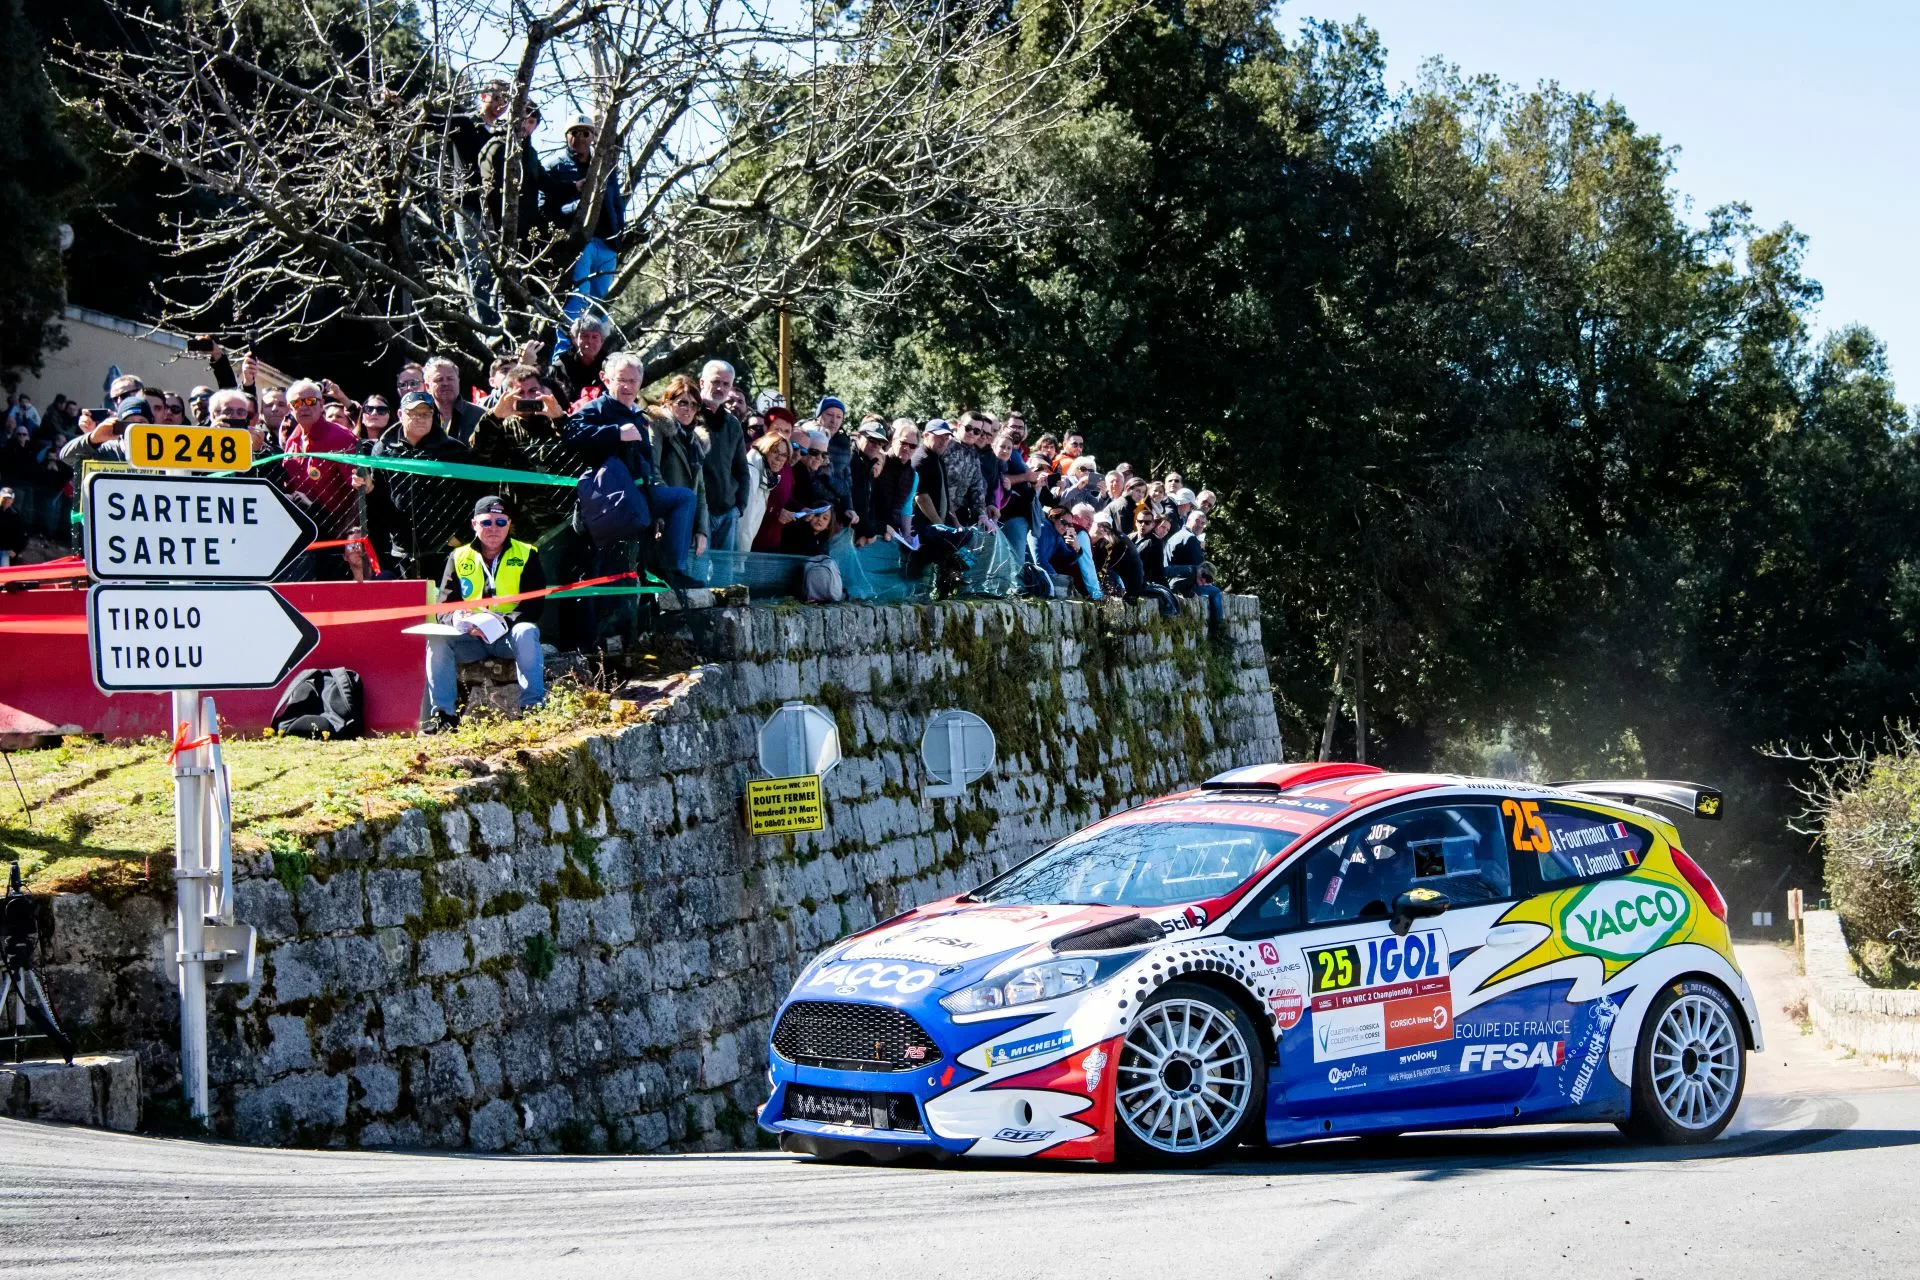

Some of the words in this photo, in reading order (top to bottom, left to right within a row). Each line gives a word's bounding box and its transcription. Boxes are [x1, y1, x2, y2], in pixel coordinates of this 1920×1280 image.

[146, 432, 164, 461] D
[174, 433, 237, 464] 248
[108, 492, 259, 525] SARTENE
[108, 606, 201, 631] TIROLO
[111, 645, 203, 669] TIROLU
[754, 794, 781, 806] ROUTE
[784, 791, 816, 803] FERMEE
[753, 806, 786, 817] Vendredi
[788, 806, 797, 814] 29
[800, 805, 818, 813] Mars
[754, 820, 763, 829] de
[764, 818, 786, 828] 08h02
[1501, 799, 1553, 853] 25
[1549, 830, 1562, 852] A
[1556, 825, 1611, 850] Fourmaux
[1572, 855, 1586, 878] R
[1585, 847, 1622, 876] Jamoul
[1574, 890, 1678, 942] YACCO
[1250, 967, 1275, 979] RALLYE
[1318, 949, 1353, 989] 25
[1366, 933, 1440, 986] IGOL
[807, 962, 936, 994] YACCO
[1342, 995, 1353, 1005] FIA
[1353, 993, 1367, 1003] WRC
[1367, 992, 1372, 1001] 2
[1373, 987, 1413, 1000] Championship
[1691, 983, 1730, 1009] MICHELIN
[1278, 1011, 1296, 1021] 2018
[1359, 1022, 1380, 1031] CORSICA
[1390, 1017, 1417, 1029] CORSICA
[1417, 1015, 1433, 1024] linea
[1455, 1022, 1501, 1039] EQUIPE
[1504, 1021, 1520, 1037] DE
[1523, 1019, 1571, 1036] FRANCE
[904, 1046, 926, 1059] RS
[1010, 1033, 1072, 1057] MICHELIN
[1406, 1049, 1437, 1063] valoxy
[1459, 1041, 1553, 1073] FFSA
